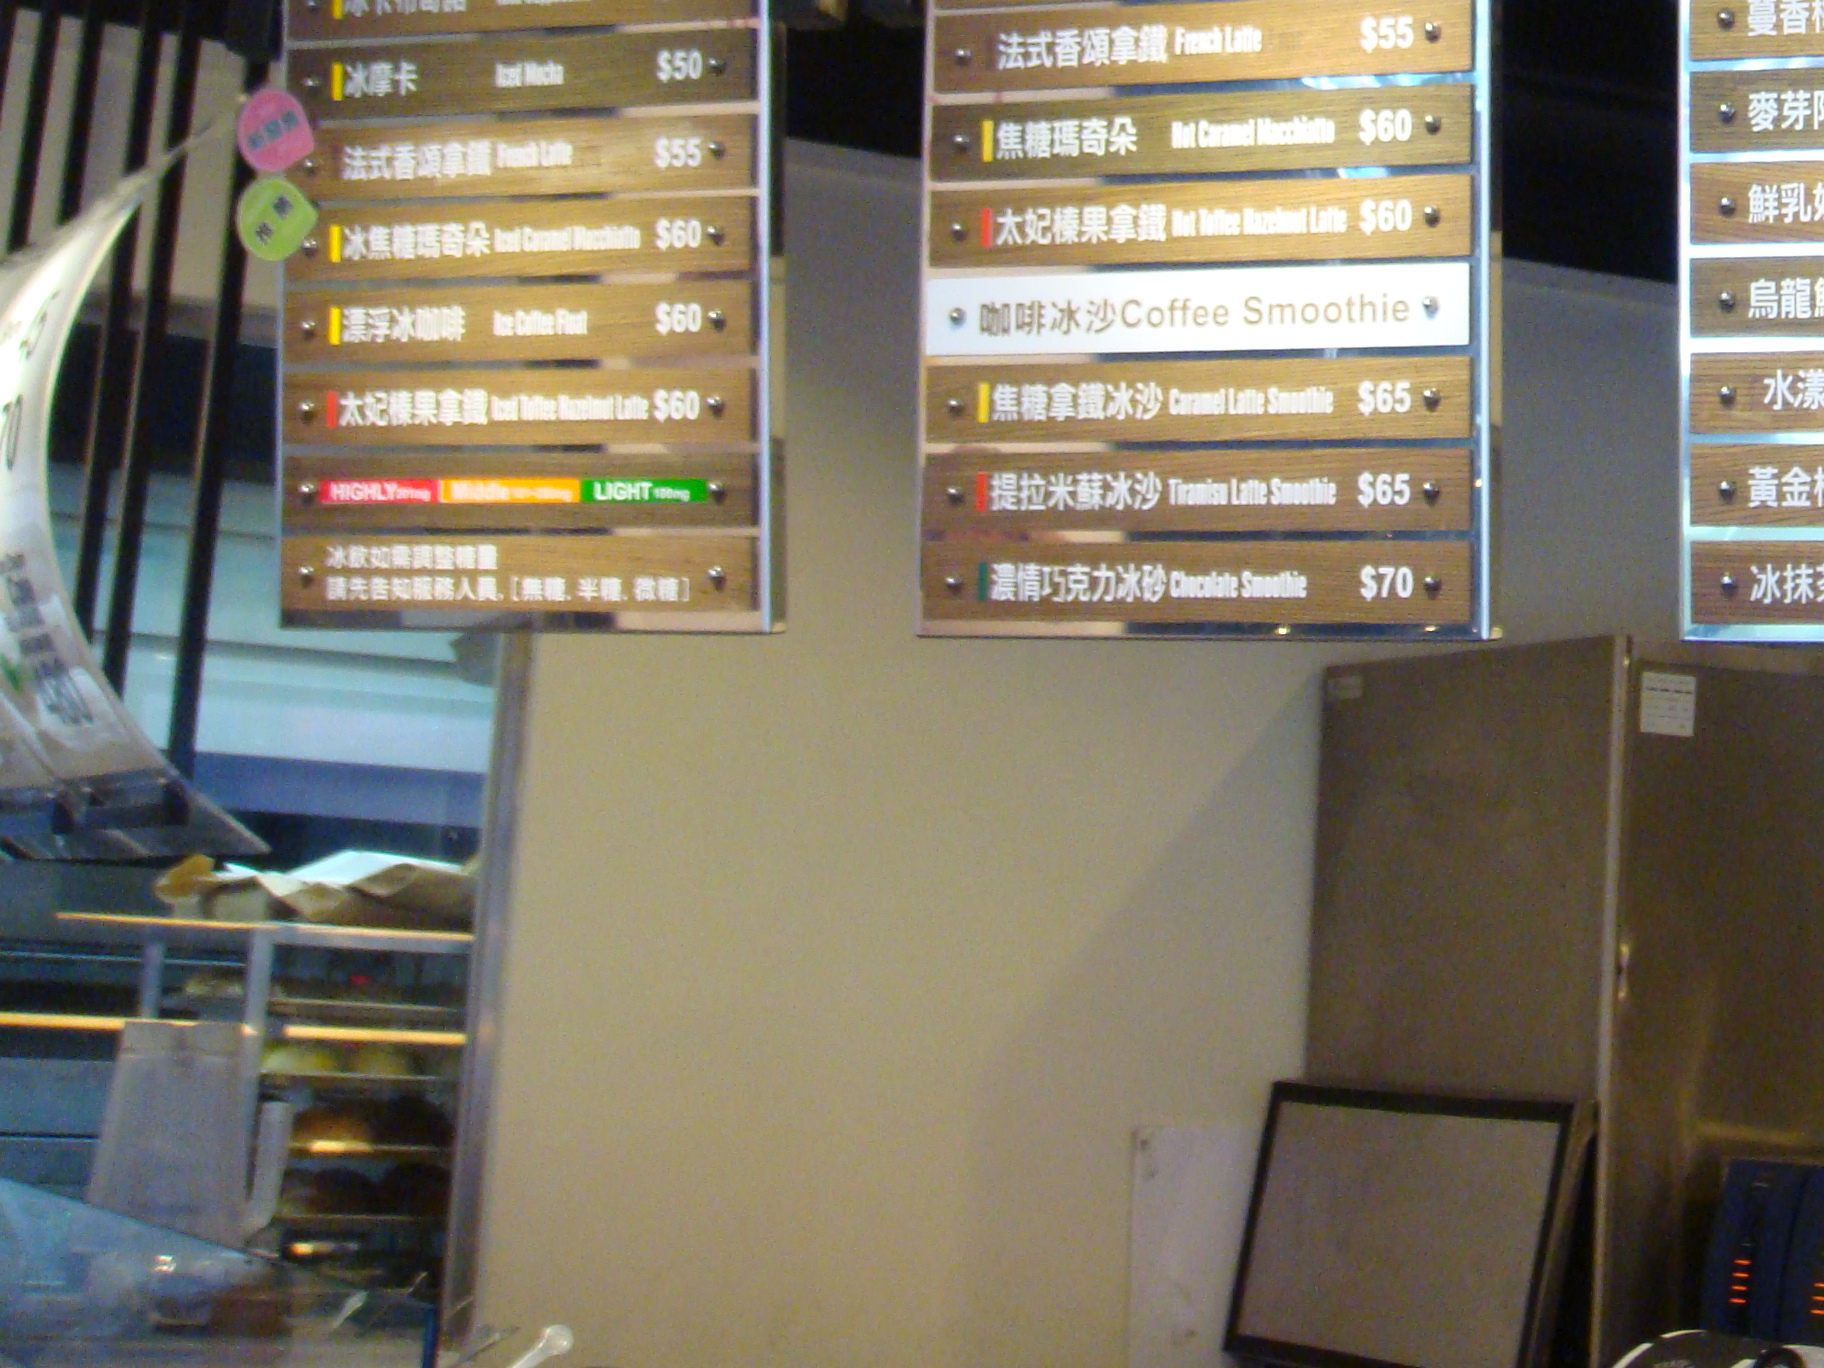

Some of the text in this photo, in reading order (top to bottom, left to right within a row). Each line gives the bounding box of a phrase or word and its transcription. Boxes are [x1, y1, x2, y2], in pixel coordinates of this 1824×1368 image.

[999, 16, 1414, 69] 法式香頌拿鐵 $55
[657, 50, 702, 81] $50
[1359, 109, 1412, 145] $60
[654, 136, 701, 168] $55
[655, 219, 701, 250] $60
[997, 199, 1412, 244] 太妃榛果拿鐵 $60
[656, 302, 701, 334] $60
[1244, 294, 1409, 325] Smoothie
[653, 389, 699, 421] $60
[1358, 380, 1411, 416] $65
[330, 482, 396, 501] HIGHLY
[594, 482, 651, 501] LIGHT
[1358, 472, 1410, 507] $65
[1360, 565, 1413, 601] $70
